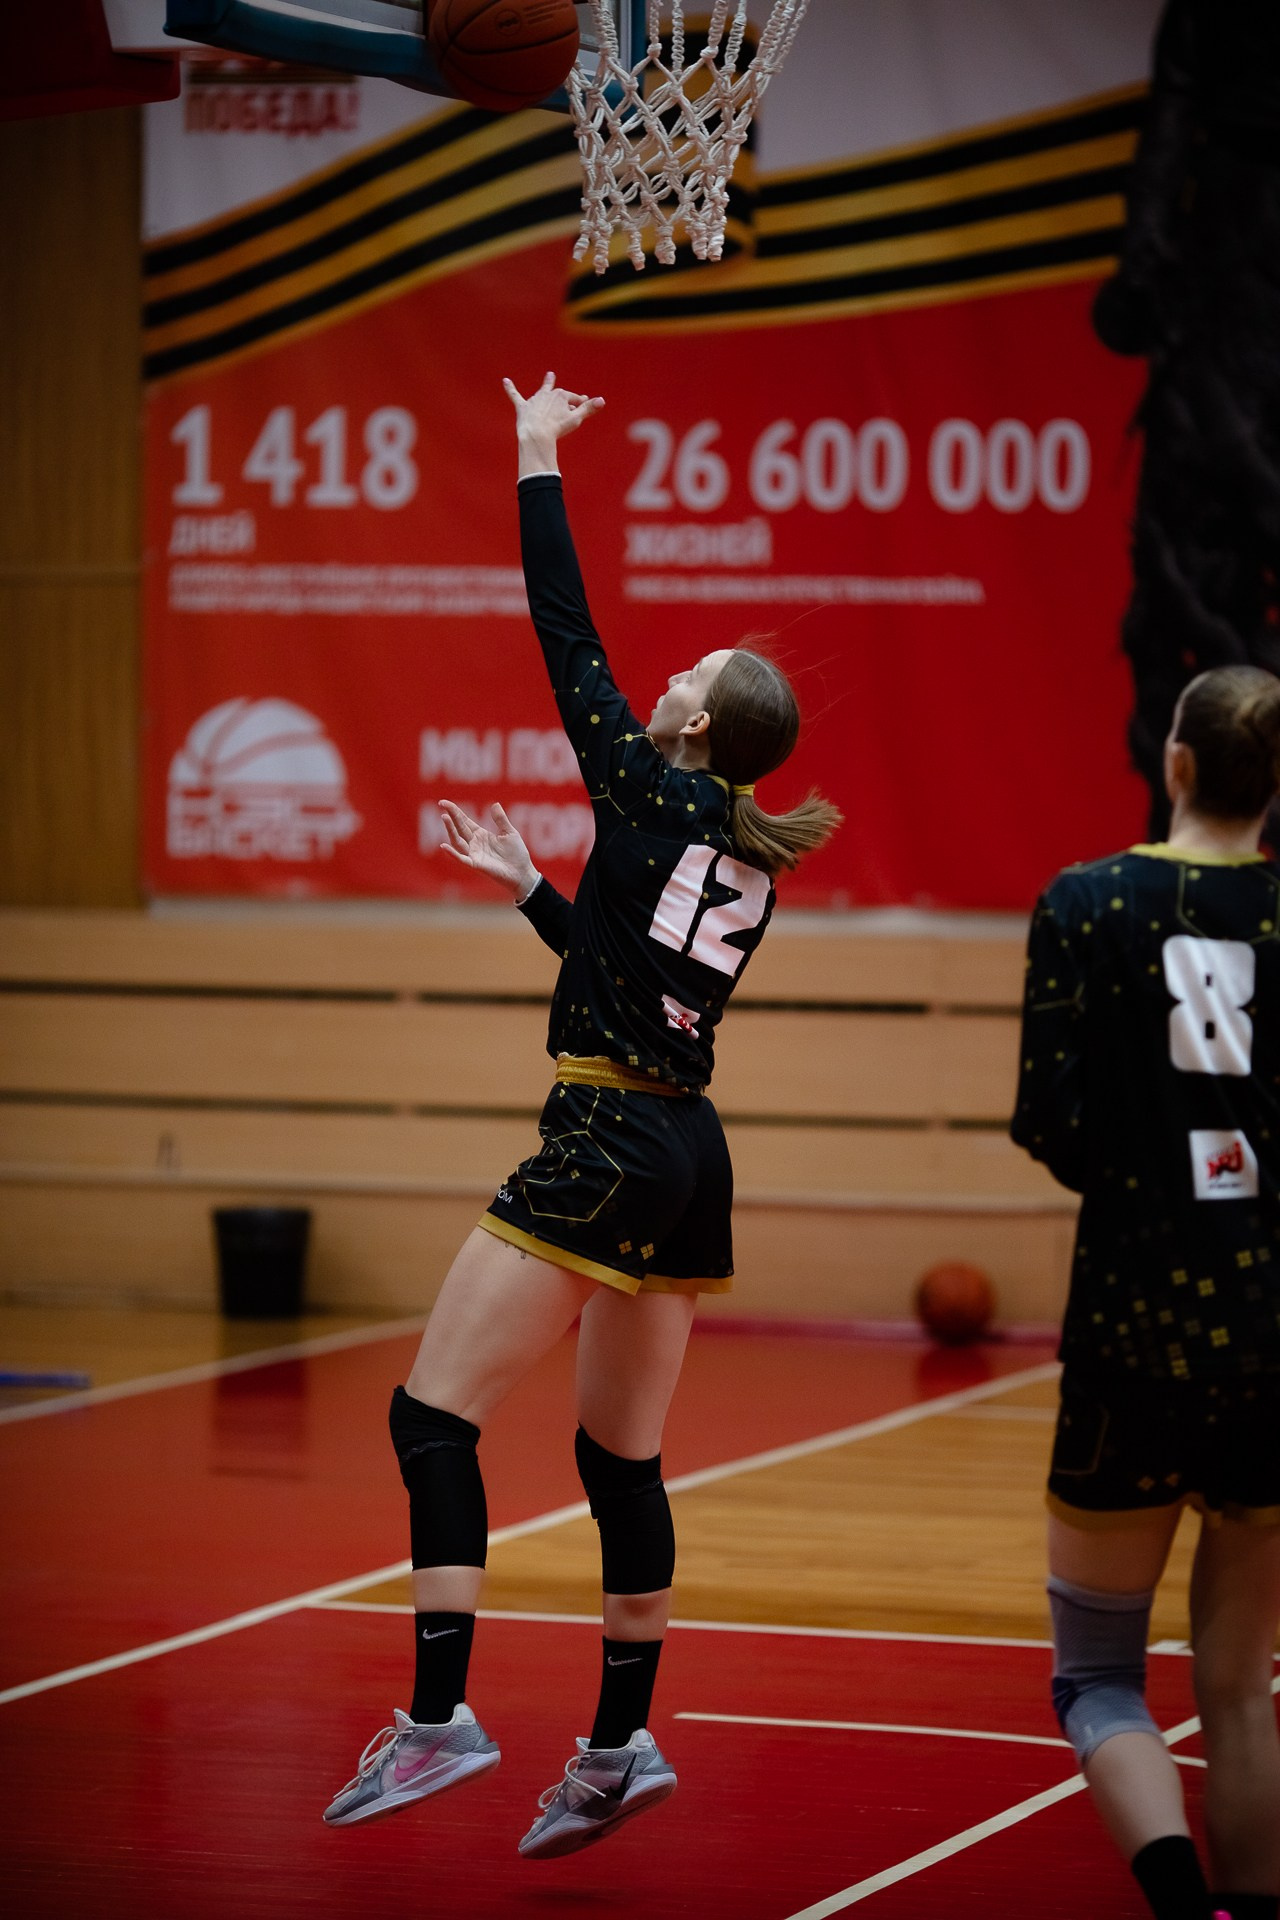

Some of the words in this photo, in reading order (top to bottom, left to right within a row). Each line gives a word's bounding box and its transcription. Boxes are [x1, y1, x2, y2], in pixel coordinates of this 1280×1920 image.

[171, 404, 223, 508] 1
[242, 405, 419, 510] 418
[625, 418, 731, 513] 26
[749, 418, 909, 514] 600
[927, 418, 1092, 514] 000
[624, 516, 772, 566] ЖИЗНЕЙ
[507, 727, 585, 785] ПО
[648, 844, 771, 977] 12
[1162, 934, 1255, 1076] 8
